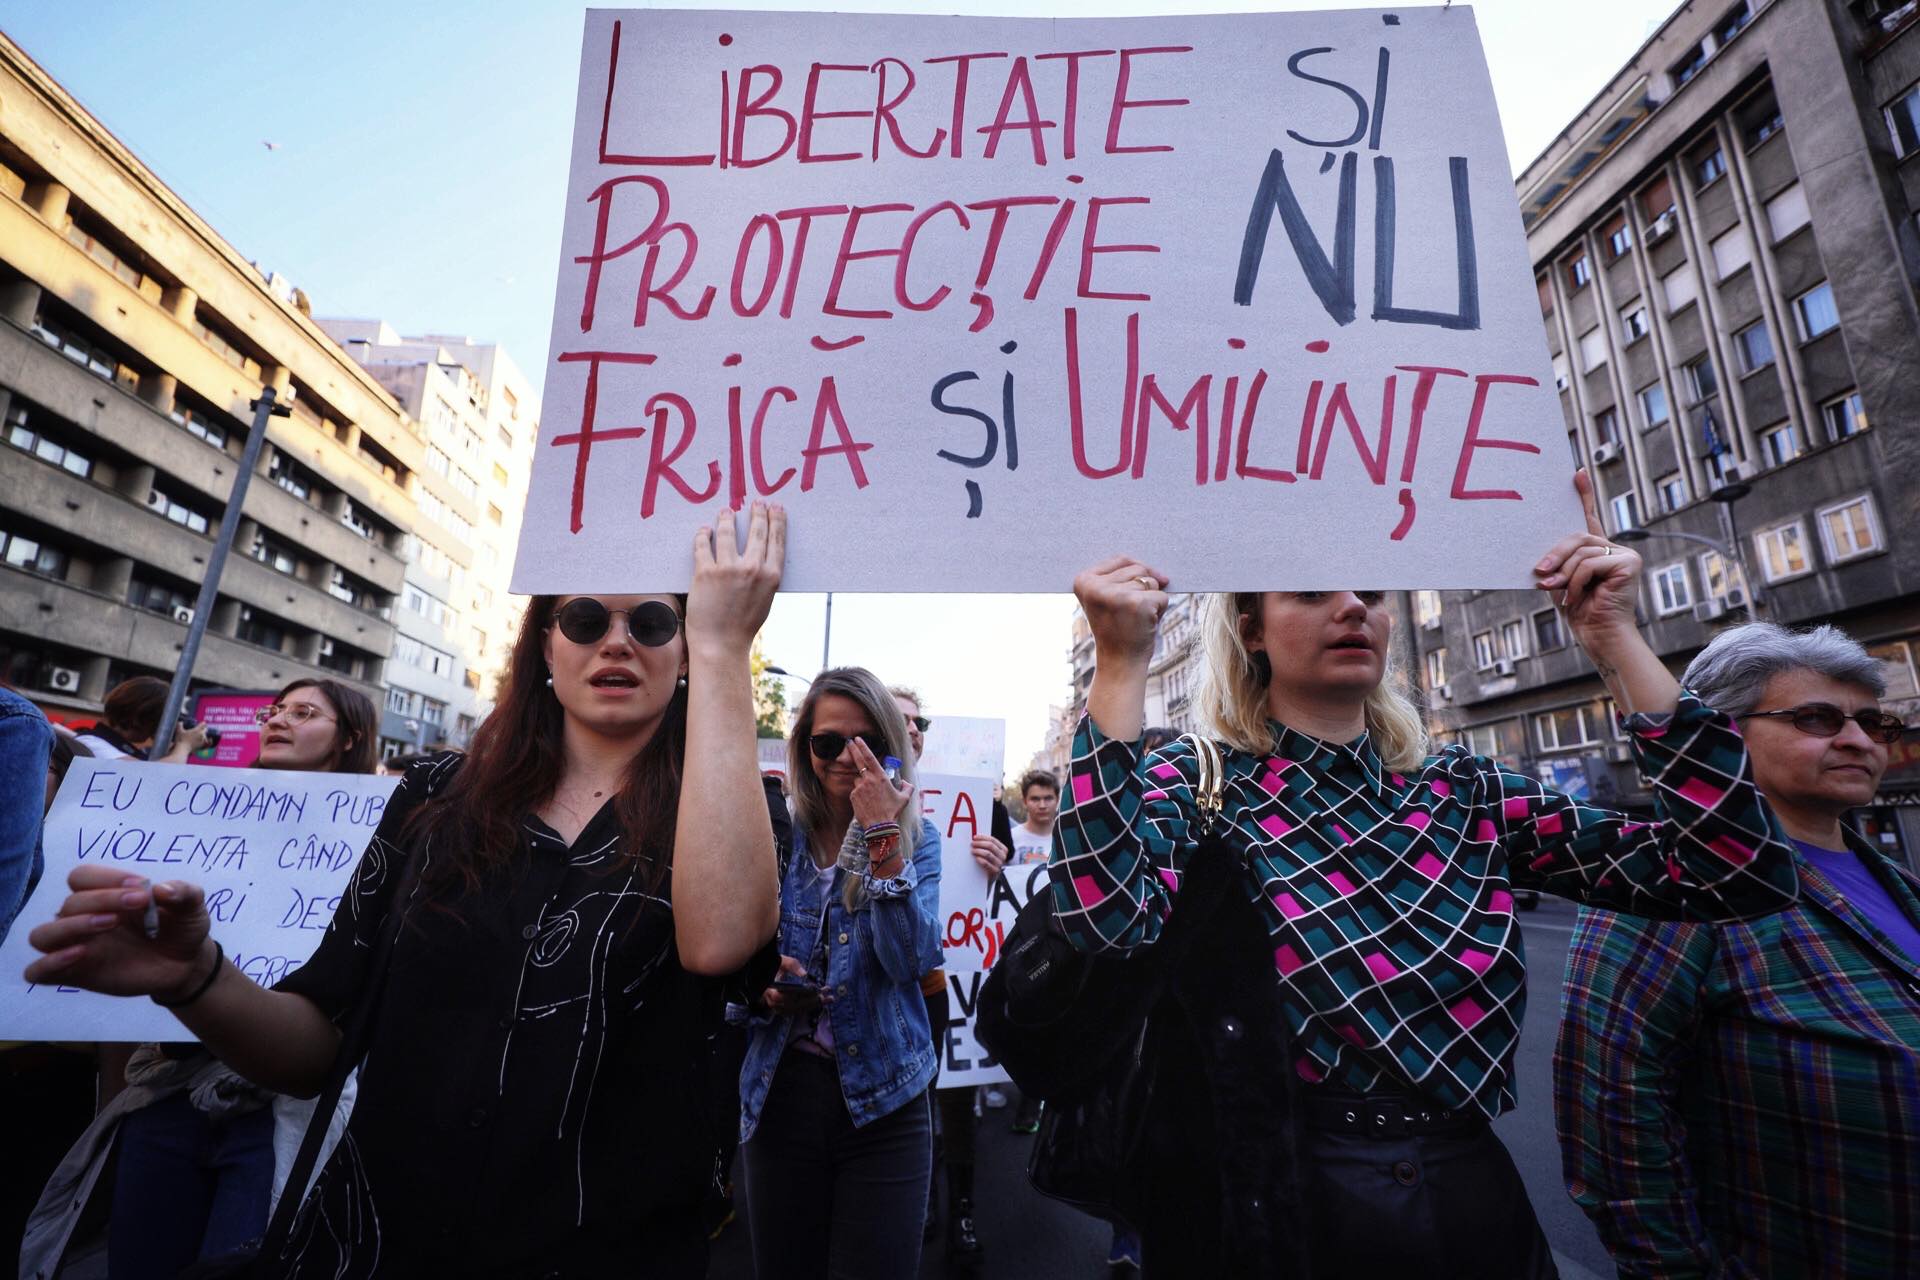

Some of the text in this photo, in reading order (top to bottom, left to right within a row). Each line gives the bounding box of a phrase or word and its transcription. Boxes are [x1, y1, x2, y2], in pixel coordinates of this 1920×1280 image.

[599, 20, 1193, 169] LIBERTATE
[575, 148, 1482, 333] PROTECȚIE NU
[551, 335, 874, 534] FRICĂ
[1064, 307, 1541, 541] UMILINȚE
[76, 822, 352, 873] VIOLENȚA CÂND
[80, 772, 385, 827] EU CONDAMN PUB
